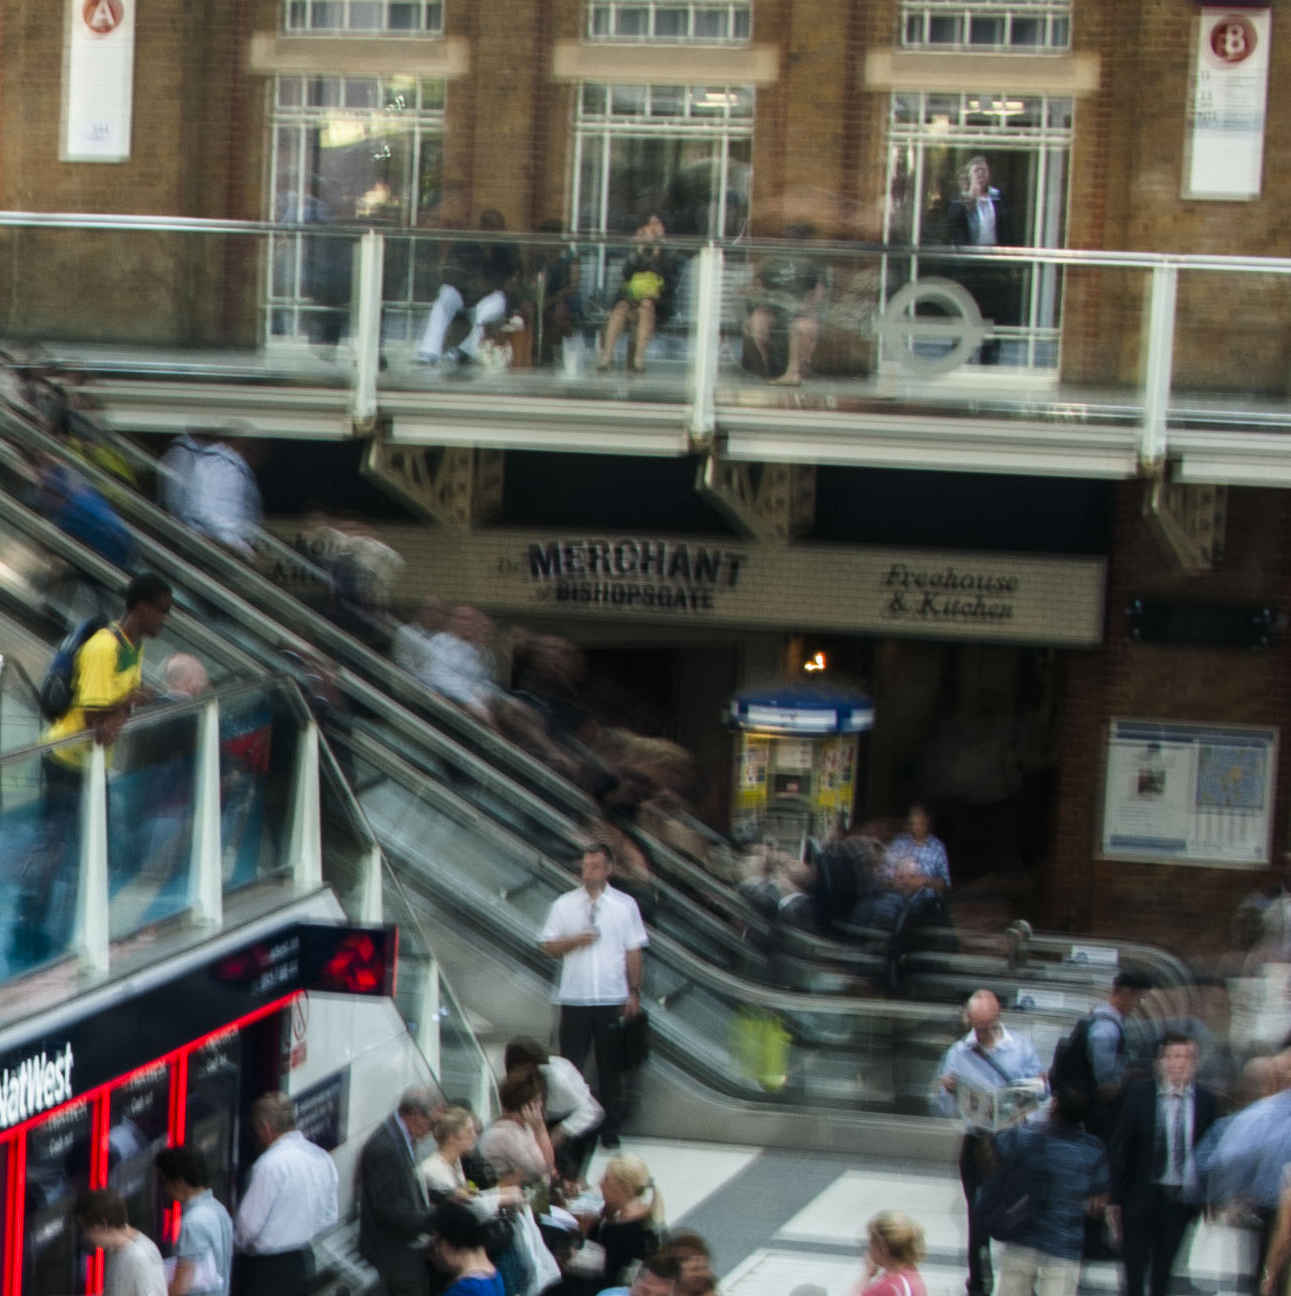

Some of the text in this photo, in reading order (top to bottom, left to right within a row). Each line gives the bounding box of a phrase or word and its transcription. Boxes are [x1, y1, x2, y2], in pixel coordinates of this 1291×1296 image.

[527, 540, 747, 588] MERCHANT
[885, 564, 1019, 593] Freehouse
[556, 582, 715, 609] BISHOPSGATE
[919, 591, 1014, 619] Kitchen
